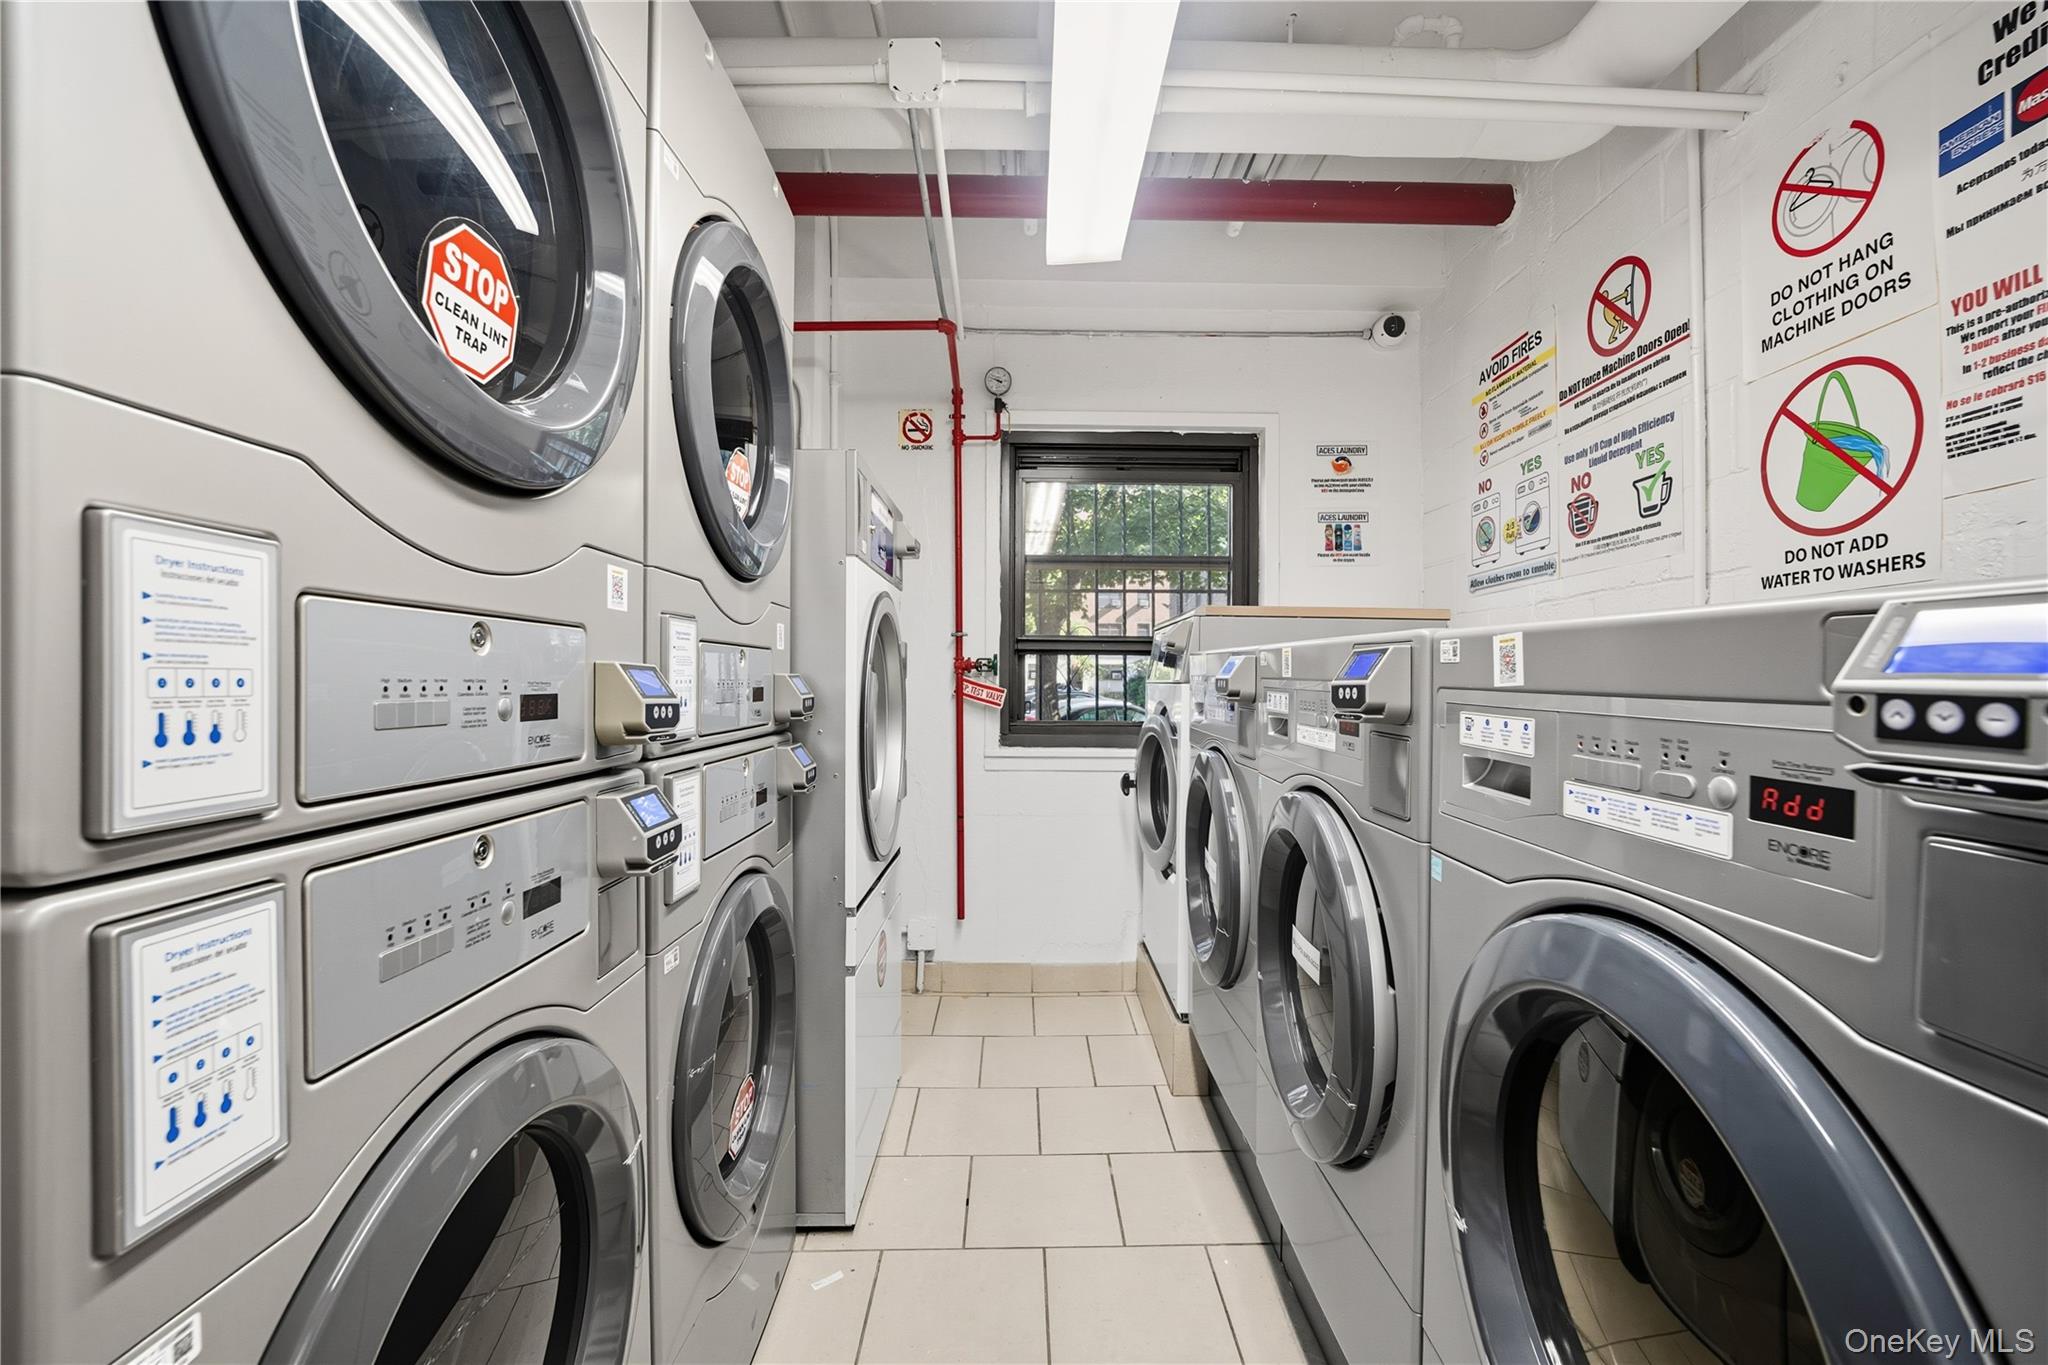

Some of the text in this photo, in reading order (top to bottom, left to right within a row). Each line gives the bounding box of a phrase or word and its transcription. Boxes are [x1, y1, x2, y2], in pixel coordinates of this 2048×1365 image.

[1992, 1, 2036, 44] We
[1956, 156, 2017, 195] Aceptamos
[1946, 223, 1965, 239] Мы
[442, 241, 510, 314] STOP
[1771, 232, 1895, 307] DO NOT HANG
[1772, 255, 1894, 327] CLOTHING ON
[1950, 264, 2043, 317] YOU WILL
[434, 291, 508, 349] CLEAN LINT
[1761, 271, 1912, 354] MACHINE DOORS
[1946, 322, 1965, 337] This
[1967, 318, 1976, 329] is
[1977, 315, 1983, 325] a
[1960, 331, 1976, 344] We
[1977, 318, 2009, 338] report
[2010, 309, 2035, 326] your
[455, 326, 488, 355] TRAP
[1963, 345, 1971, 356] 2
[1971, 335, 2000, 353] hours
[2002, 325, 2027, 342] after
[1479, 354, 1509, 386] AVOID
[1511, 330, 1543, 364] FIRES
[1559, 389, 1568, 402] Do
[1568, 379, 1581, 397] NOT
[1582, 370, 1601, 389] Force
[1602, 349, 1636, 378] Machine
[1637, 335, 1663, 359] Doors
[1664, 317, 1691, 343] Open!
[1962, 364, 1972, 375] In
[1973, 357, 1987, 371] 1-2
[1988, 342, 2036, 366] business
[1983, 360, 2015, 380] reflect
[2017, 354, 2035, 369] the
[1946, 399, 1959, 411] No
[1564, 454, 1575, 466] Use
[1575, 447, 1588, 462] only
[1600, 436, 1613, 451] Cup
[1613, 432, 1621, 446] of
[1621, 425, 1638, 442] High
[1638, 411, 1676, 435] Efficiency
[1588, 438, 1643, 469] Liquid Detergent
[1520, 454, 1543, 477] YES
[1635, 442, 1666, 470] YES
[1478, 478, 1493, 495] NO
[1571, 471, 1593, 494] NO
[155, 554, 245, 577] Dryer Instructions
[1784, 532, 1889, 565] DO NOT ADD
[1760, 551, 1927, 590] WATER TO WASHERS
[1762, 786, 1825, 822] Add
[1767, 838, 1832, 865] ENCORE
[164, 946, 194, 963] Dryer
[196, 927, 253, 952] Instructions
